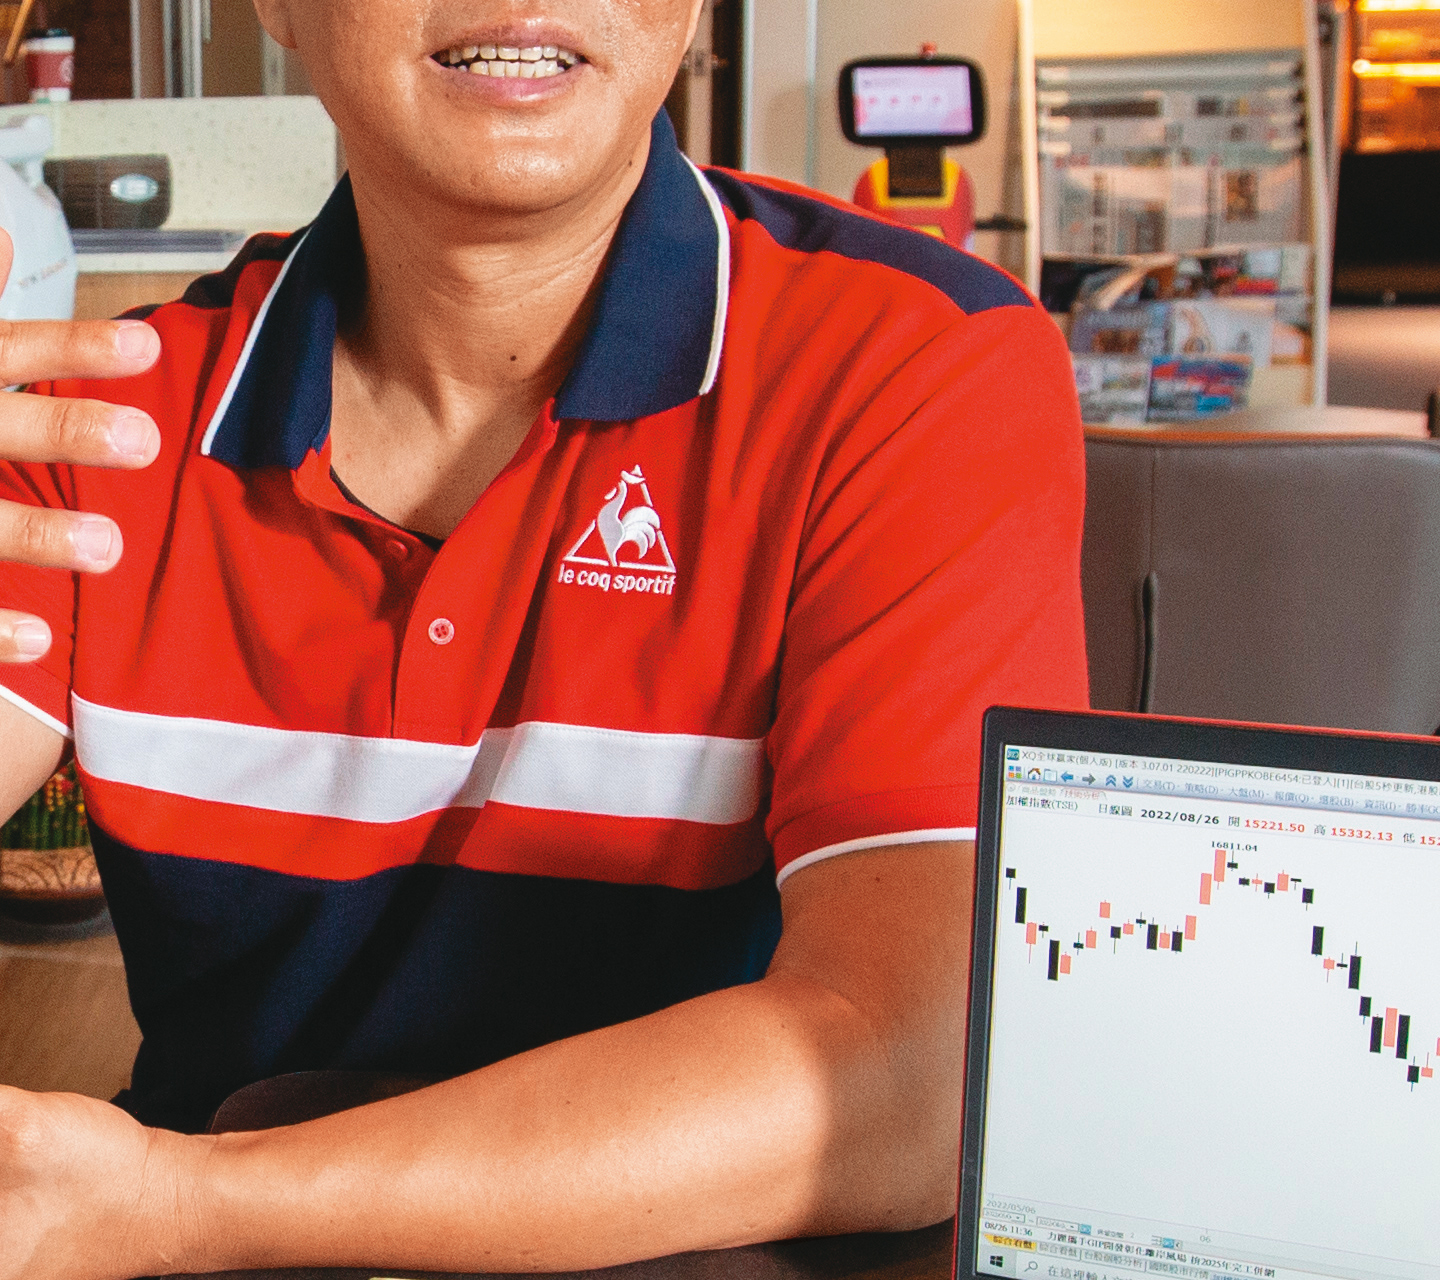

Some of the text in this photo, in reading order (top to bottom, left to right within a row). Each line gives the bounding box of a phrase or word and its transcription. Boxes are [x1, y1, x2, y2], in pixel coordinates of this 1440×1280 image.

[557, 563, 677, 596] le coq sportif
[1005, 793, 1080, 813] 加權指數(TSE)
[1096, 802, 1134, 818] 日線圖
[1139, 808, 1221, 826] 2022/08/26
[1243, 818, 1306, 834] 15221.50
[1313, 823, 1327, 836] 高
[1330, 826, 1394, 842] 15332.13
[1402, 831, 1416, 844] 低
[1210, 839, 1259, 853] 16811.04
[986, 1198, 1037, 1215] 2022/05/06
